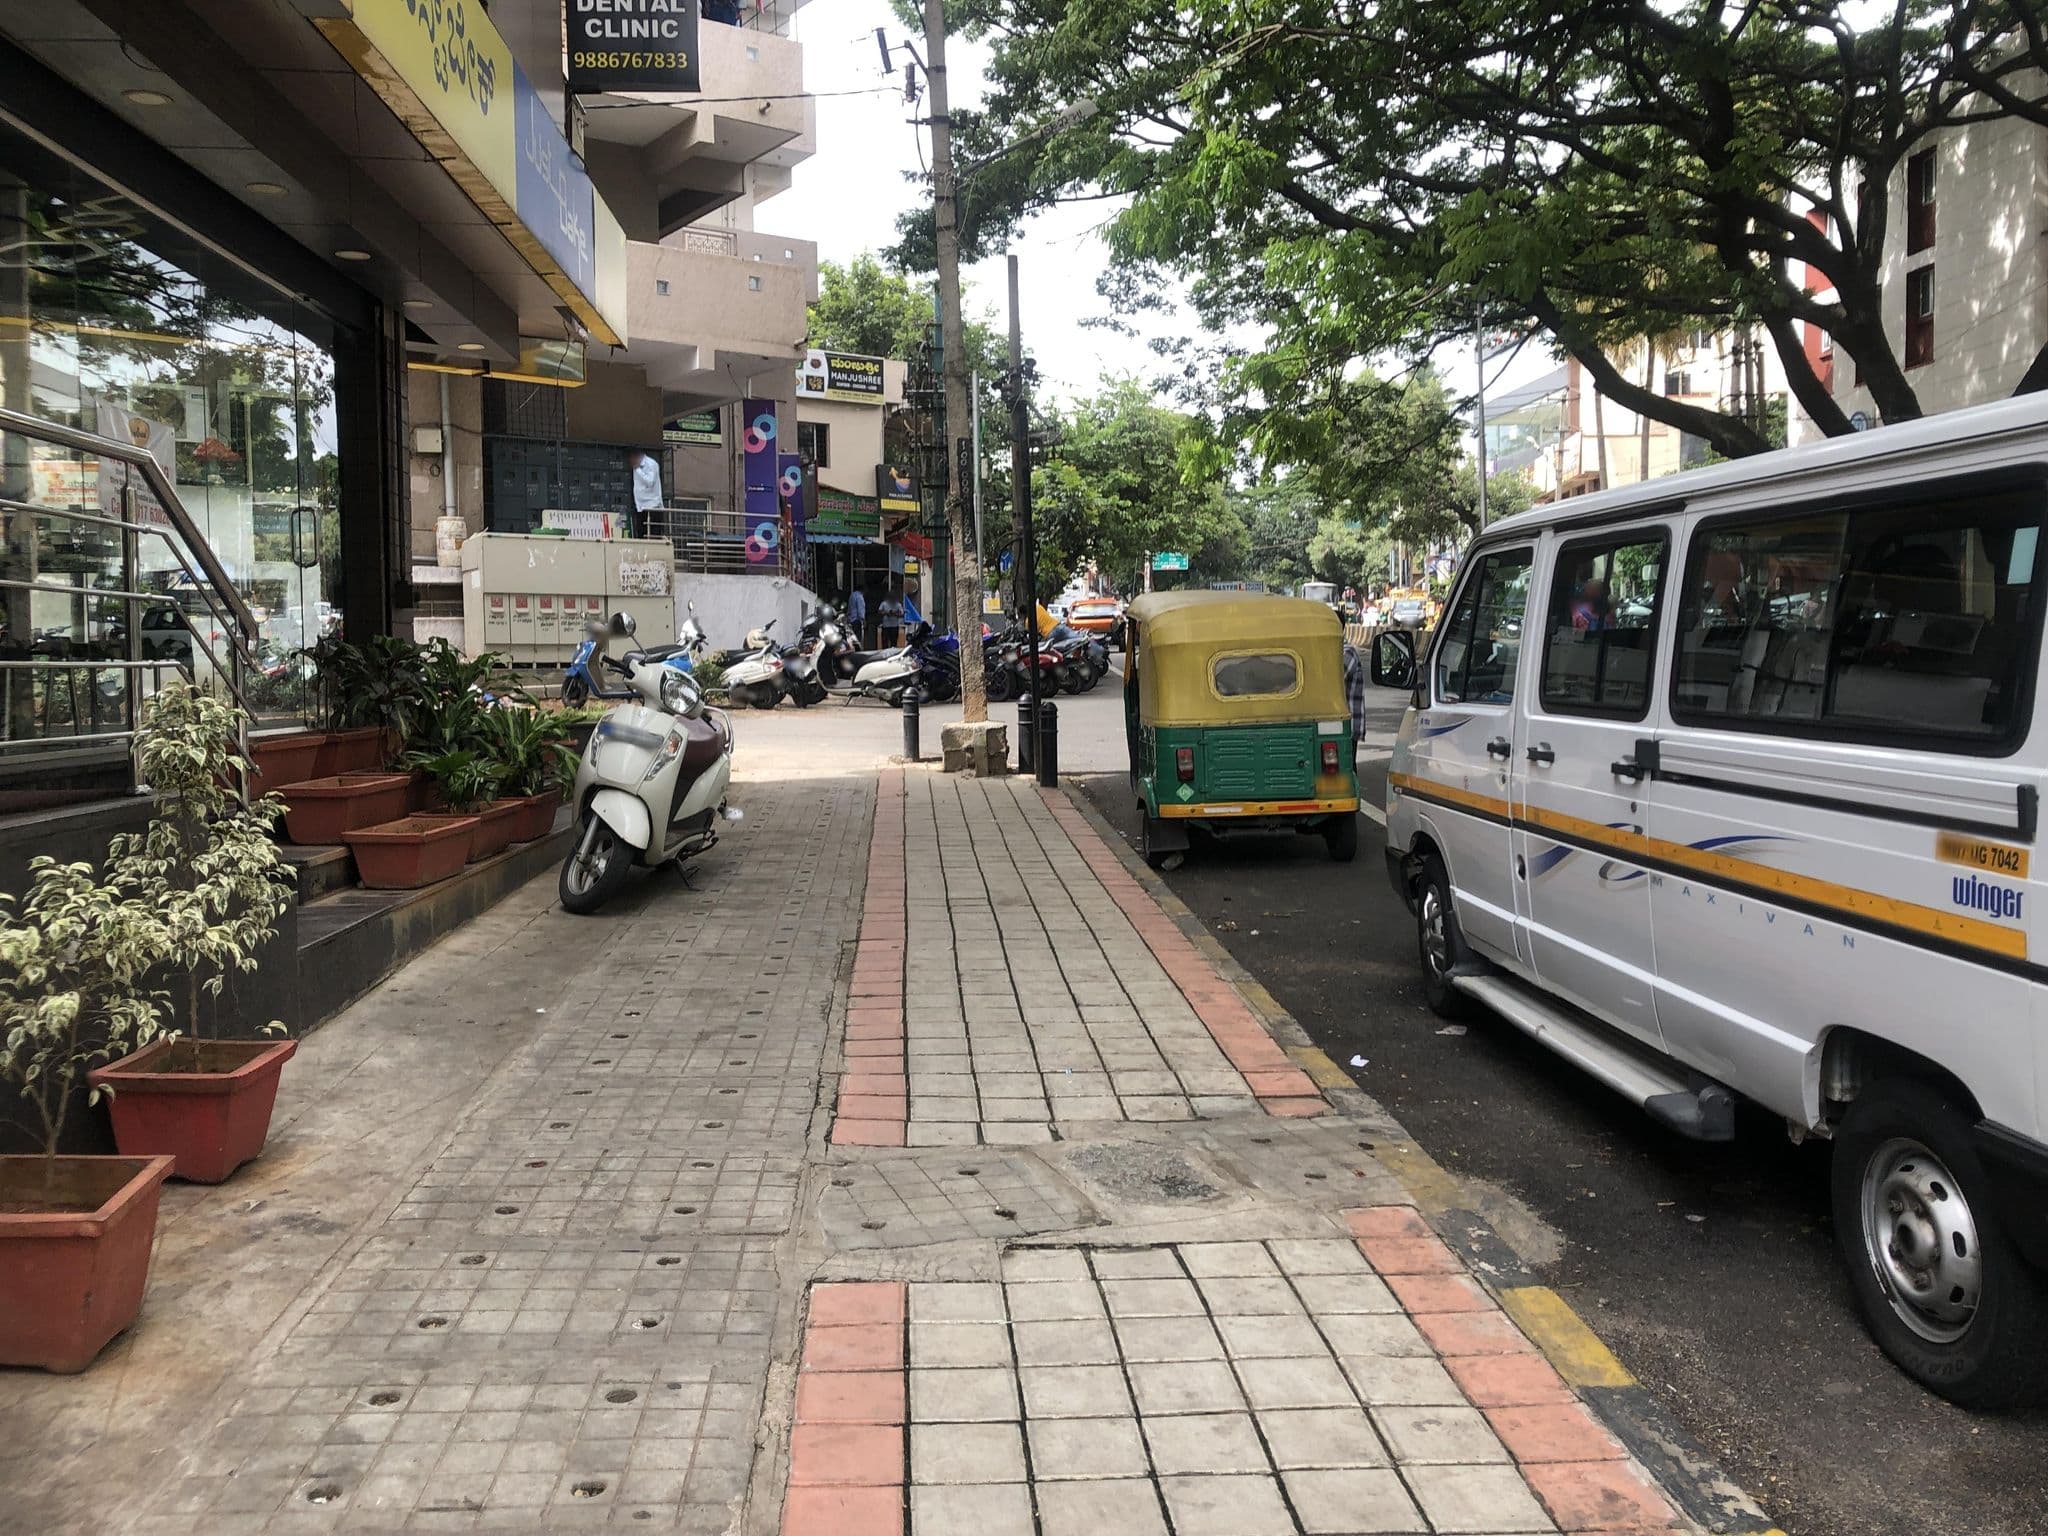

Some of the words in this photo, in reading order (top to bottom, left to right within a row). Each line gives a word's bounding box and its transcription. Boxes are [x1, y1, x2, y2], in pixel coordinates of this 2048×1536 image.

[577, 0, 686, 13] DENTAL
[584, 18, 679, 38] CLINIC
[574, 51, 688, 69] 9886767833
[831, 371, 882, 386] MANJUSHREE
[1990, 848, 2020, 871] 7042
[1953, 874, 2024, 919] winger
